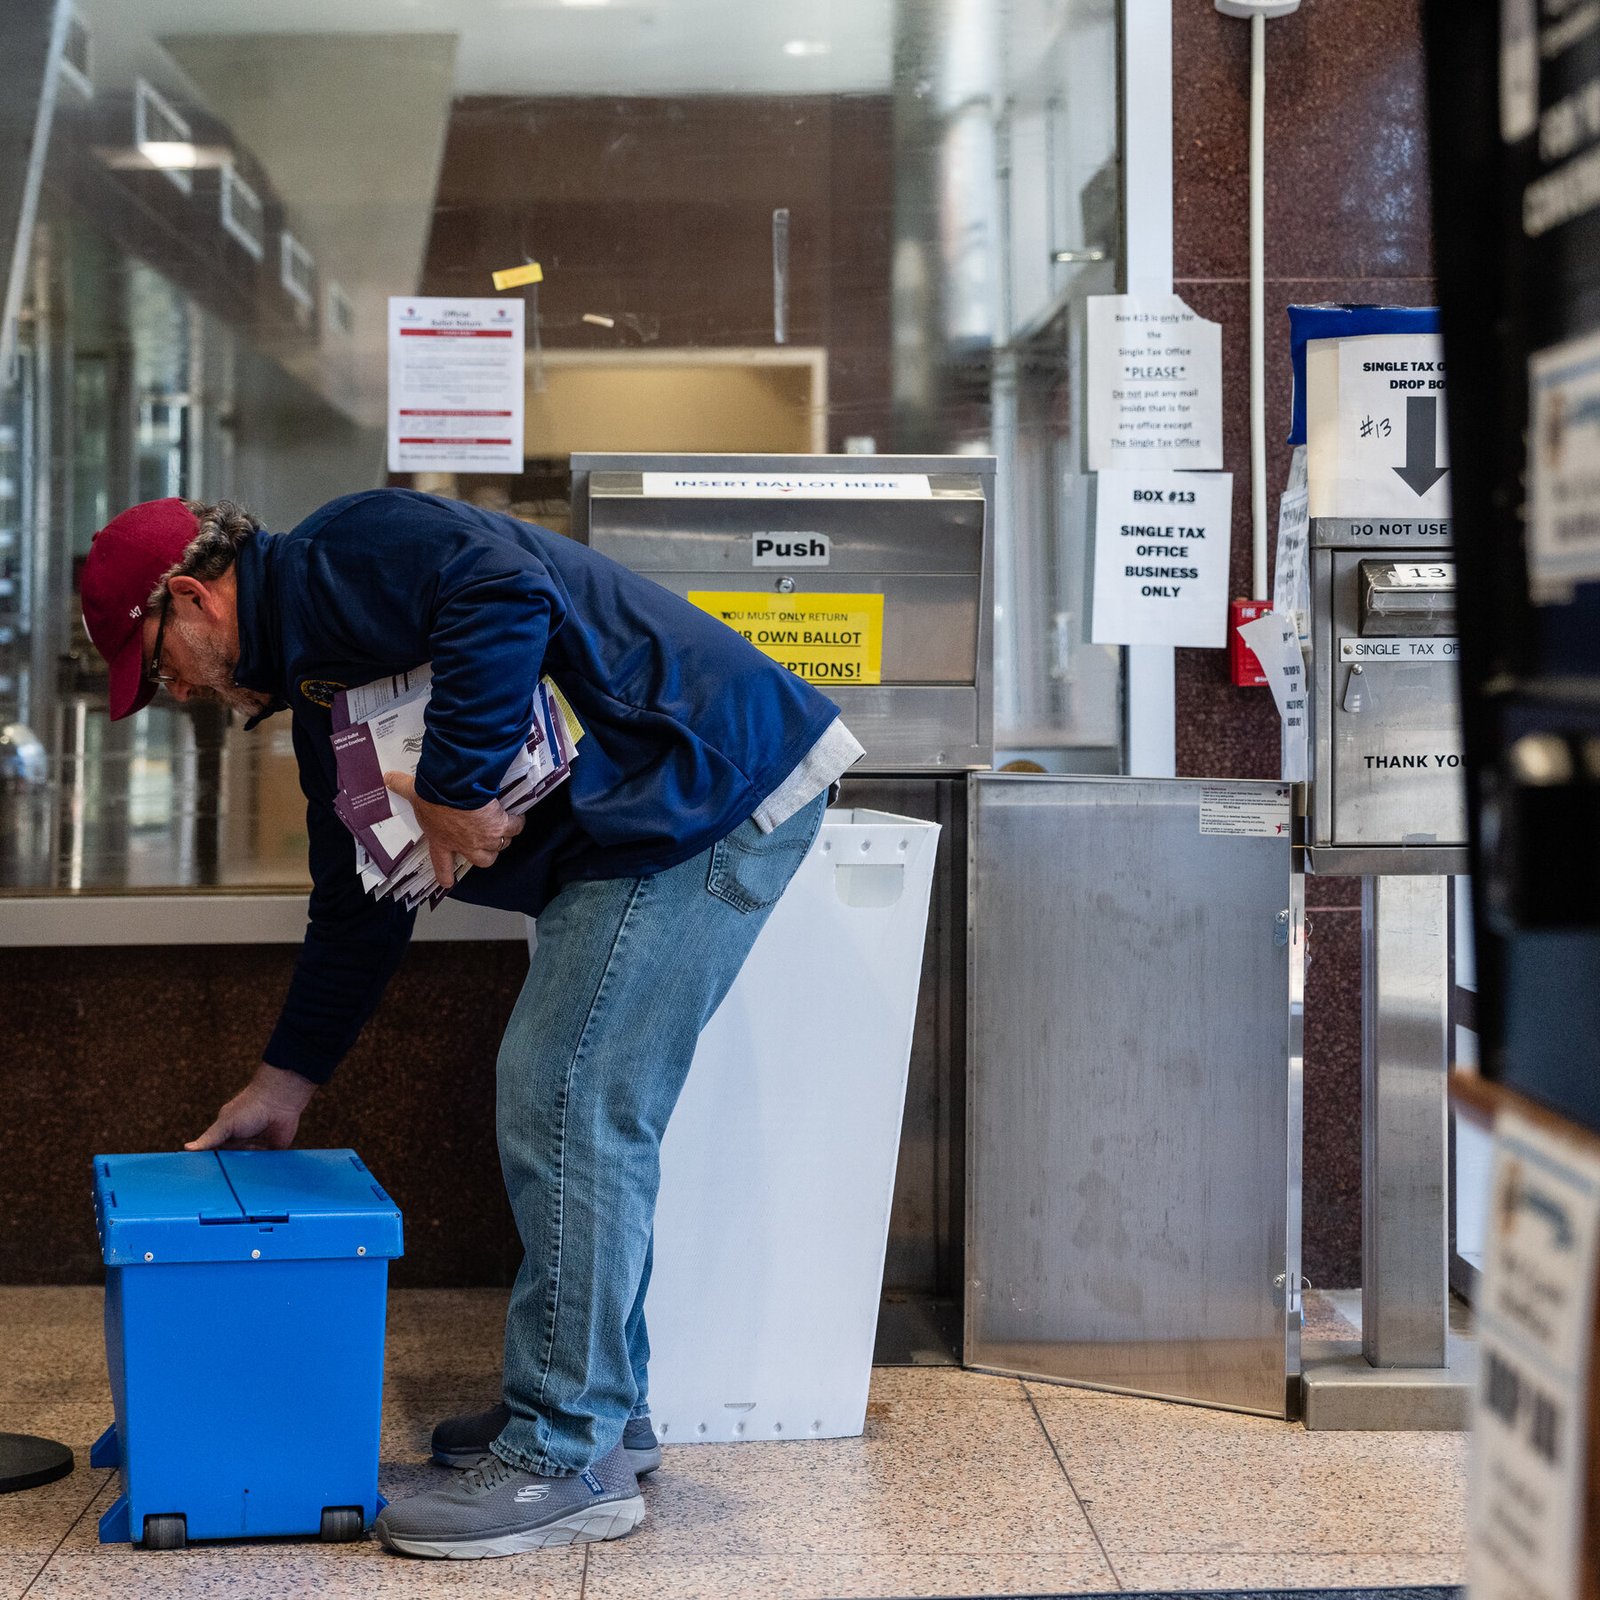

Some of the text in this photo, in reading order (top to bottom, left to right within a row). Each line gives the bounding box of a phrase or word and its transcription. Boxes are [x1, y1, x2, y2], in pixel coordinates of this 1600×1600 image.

[1119, 349, 1144, 357] Single
[1165, 348, 1191, 356] Office
[1362, 362, 1408, 372] SINGLE
[1410, 362, 1433, 372] TAX
[1389, 379, 1447, 390] DROP BO
[1127, 390, 1142, 398] not
[1144, 390, 1160, 399] put
[1162, 391, 1177, 399] any
[1180, 389, 1199, 398] mail
[1137, 421, 1161, 429] office
[1163, 422, 1192, 430] except
[1359, 415, 1392, 438] #13
[1110, 438, 1200, 448] The Single Tax Office
[675, 480, 749, 488] INSERT
[1133, 490, 1196, 503] BOX #13
[1120, 525, 1206, 539] SINGLE TAX
[1351, 524, 1448, 536] DO NOT USE
[755, 538, 826, 558] Push
[1136, 545, 1189, 557] OFFICE
[1125, 566, 1198, 579] BUSINESS
[1408, 567, 1447, 579] 13
[1141, 585, 1180, 598] ONLY
[747, 611, 776, 621] MUST
[778, 612, 806, 622] ONLY
[808, 613, 849, 622] RETURN
[757, 631, 798, 643] OWN
[803, 632, 861, 645] BALLOT
[1355, 643, 1400, 656] SINGLE
[1409, 643, 1434, 655] TAX
[779, 661, 861, 678] PTIONS!
[1364, 755, 1428, 769] THANK
